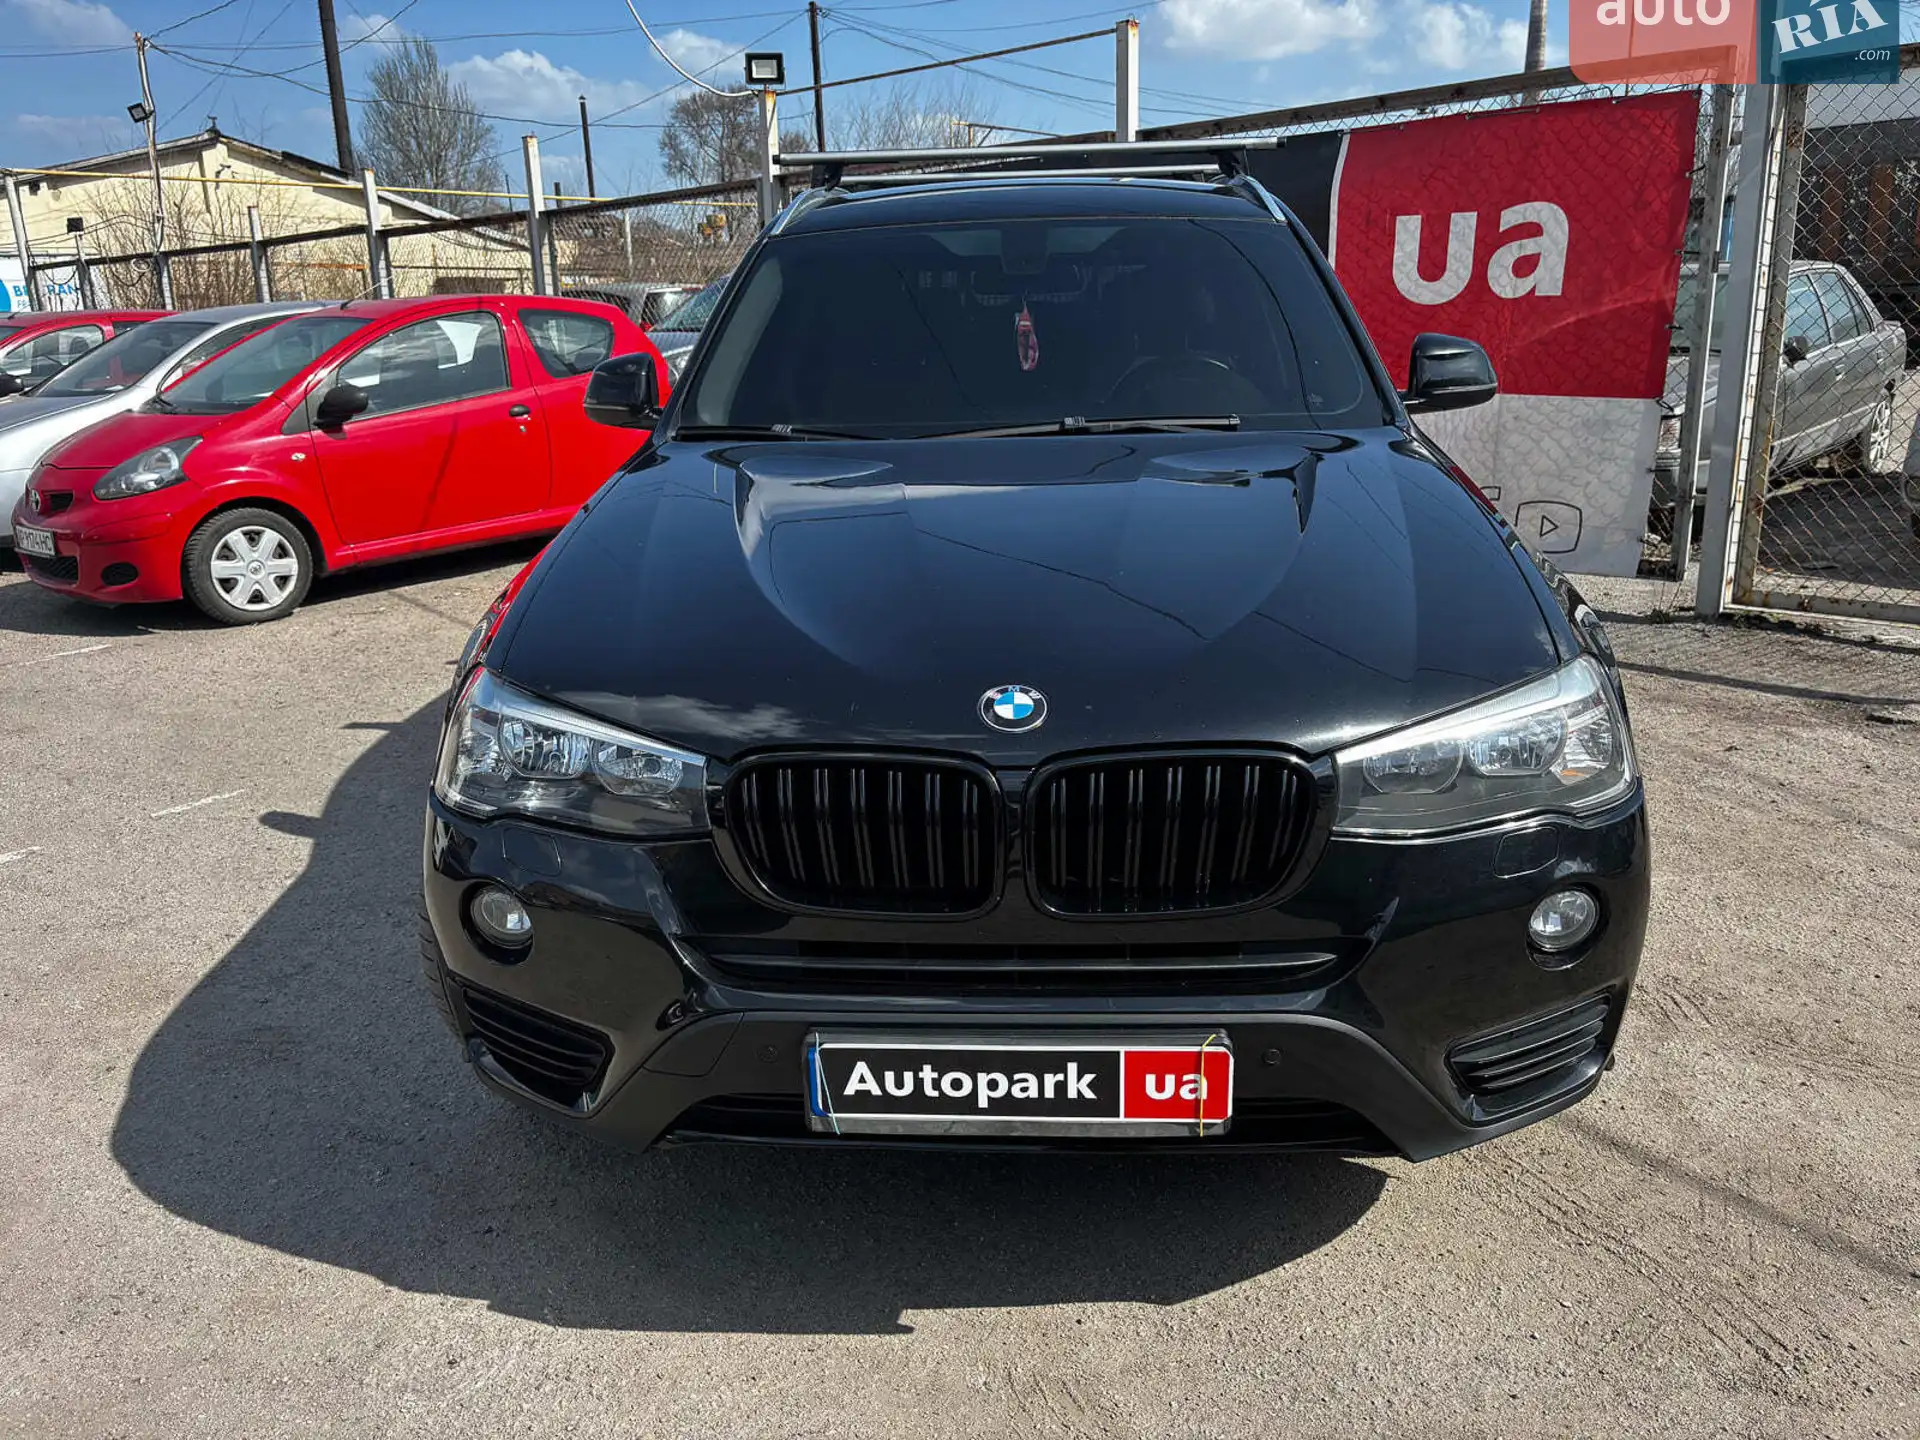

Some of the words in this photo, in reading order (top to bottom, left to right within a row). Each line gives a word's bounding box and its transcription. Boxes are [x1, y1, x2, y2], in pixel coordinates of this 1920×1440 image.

[1392, 201, 1569, 305] ua
[843, 1060, 1097, 1108] Autopark
[1145, 1072, 1208, 1100] ua
